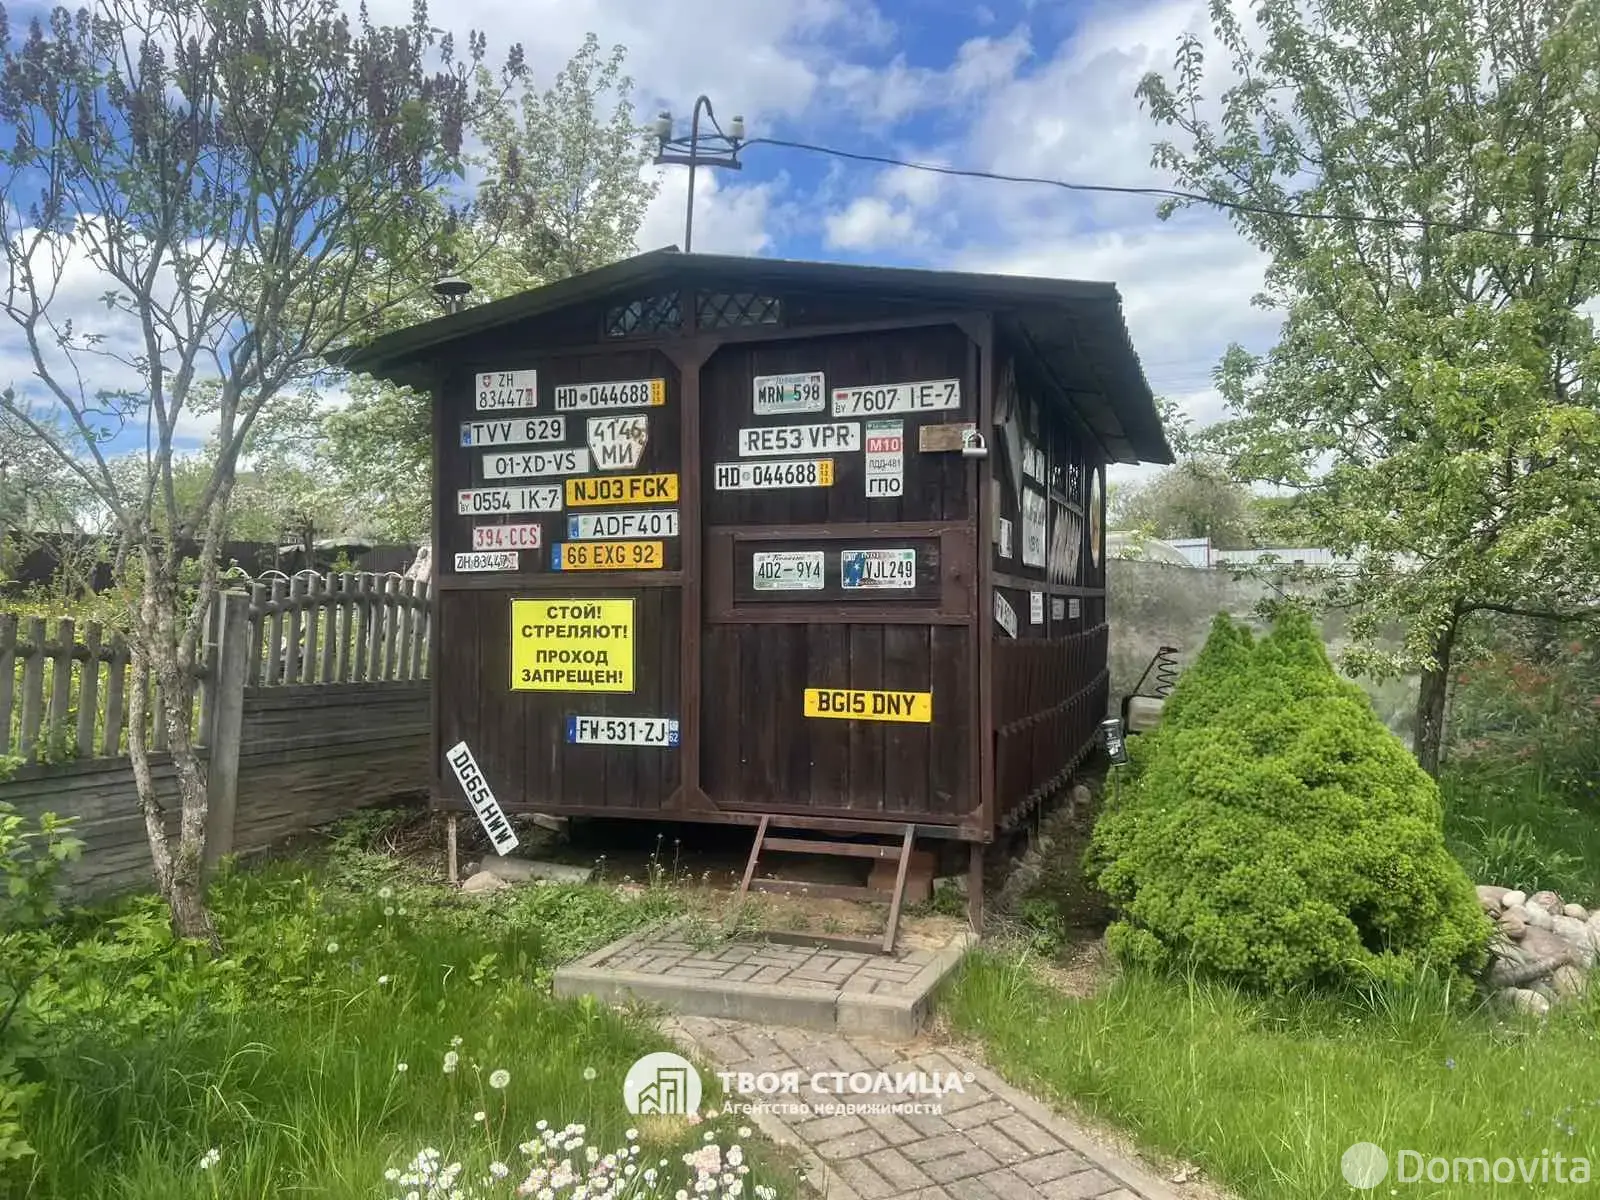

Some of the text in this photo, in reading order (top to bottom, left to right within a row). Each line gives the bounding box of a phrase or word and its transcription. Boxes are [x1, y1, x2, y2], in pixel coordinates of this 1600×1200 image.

[499, 373, 513, 387] ZH
[480, 388, 524, 408] 83447
[557, 388, 577, 408] HD
[759, 383, 820, 403] MRN 598
[852, 390, 899, 412] 7607
[473, 419, 561, 444] TVV 629
[594, 419, 642, 442] 4146
[748, 424, 850, 451] RE53 VPR
[718, 467, 740, 488] HD
[870, 478, 900, 492] ГПО
[574, 478, 669, 501] NJ03 FGK
[473, 492, 511, 511] 0554
[567, 544, 654, 565] 66 EXG 92
[866, 560, 913, 579] VJL249
[547, 603, 602, 620] СТОЙ!
[522, 625, 628, 639] СТРЕЛЯЮТ!
[536, 650, 609, 666] ПРОХОД
[521, 669, 623, 685] ЗАПРЕЩЕН!
[818, 691, 916, 716] BG15 DNY
[452, 750, 490, 804] DG65
